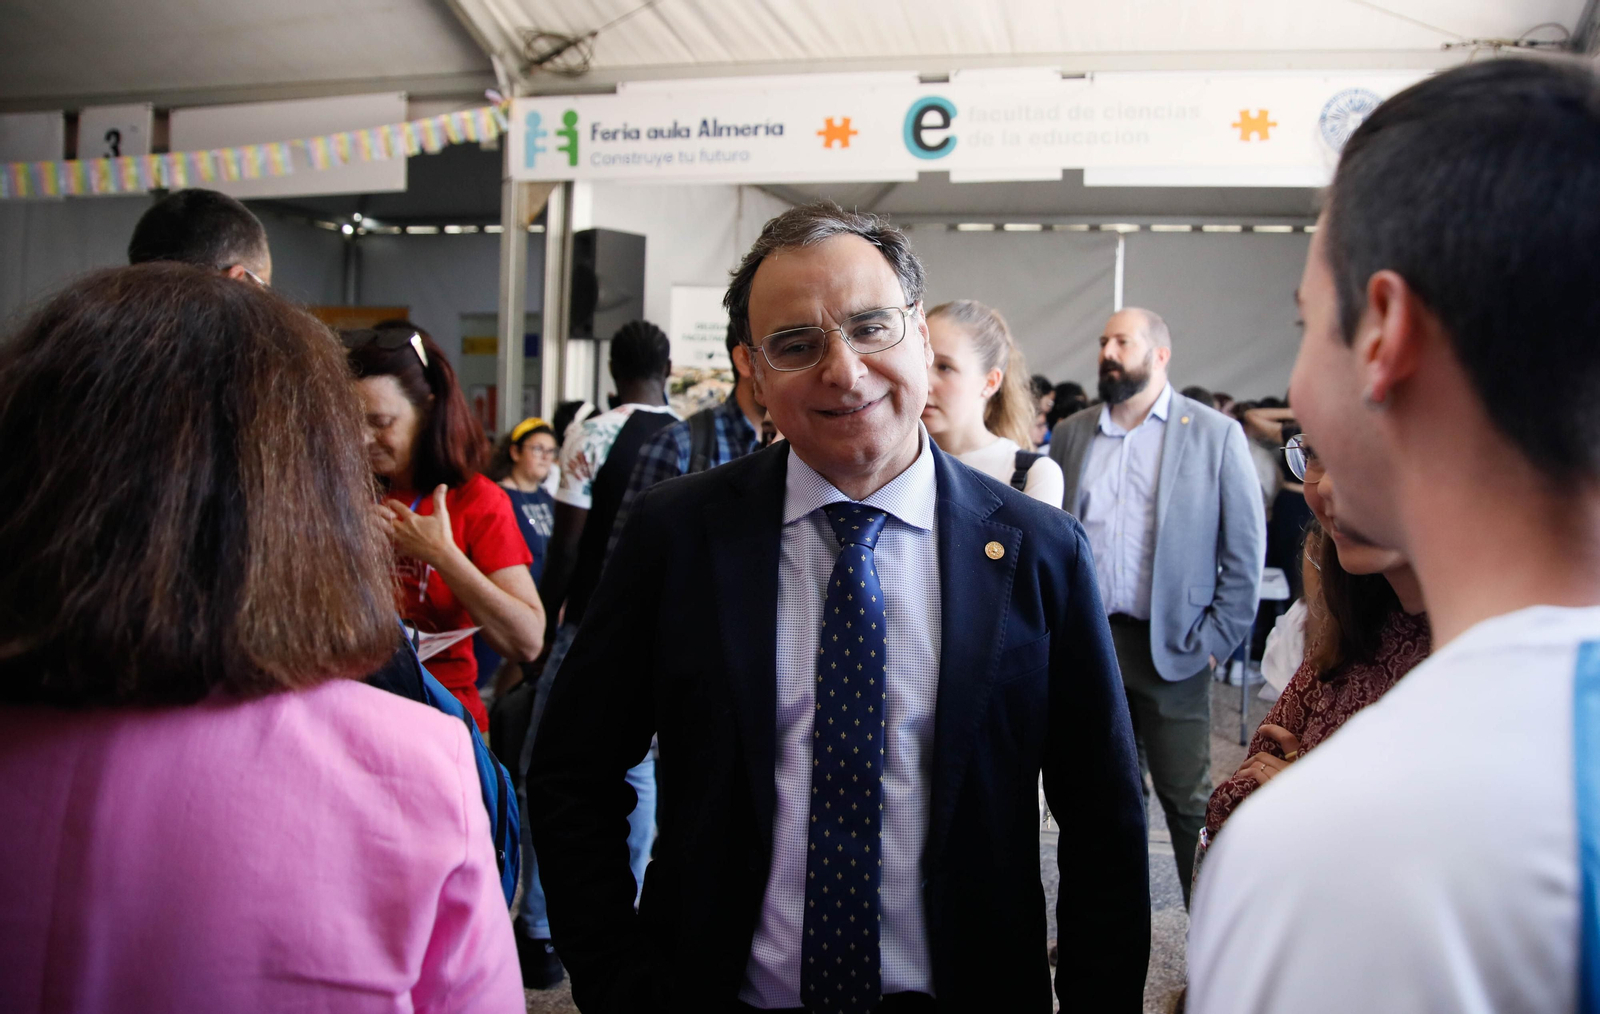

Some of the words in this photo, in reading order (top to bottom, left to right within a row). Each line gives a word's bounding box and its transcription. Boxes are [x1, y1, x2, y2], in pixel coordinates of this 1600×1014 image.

[968, 103, 1060, 122] facultad
[1067, 103, 1095, 121] de
[1102, 102, 1200, 121] ciencias
[591, 122, 640, 141] Feria
[647, 120, 690, 139] aula
[967, 131, 995, 148] de
[1001, 130, 1021, 147] la
[104, 128, 121, 158] 3
[590, 151, 674, 168] Construye
[679, 150, 695, 163] tu
[699, 148, 750, 163] futuro
